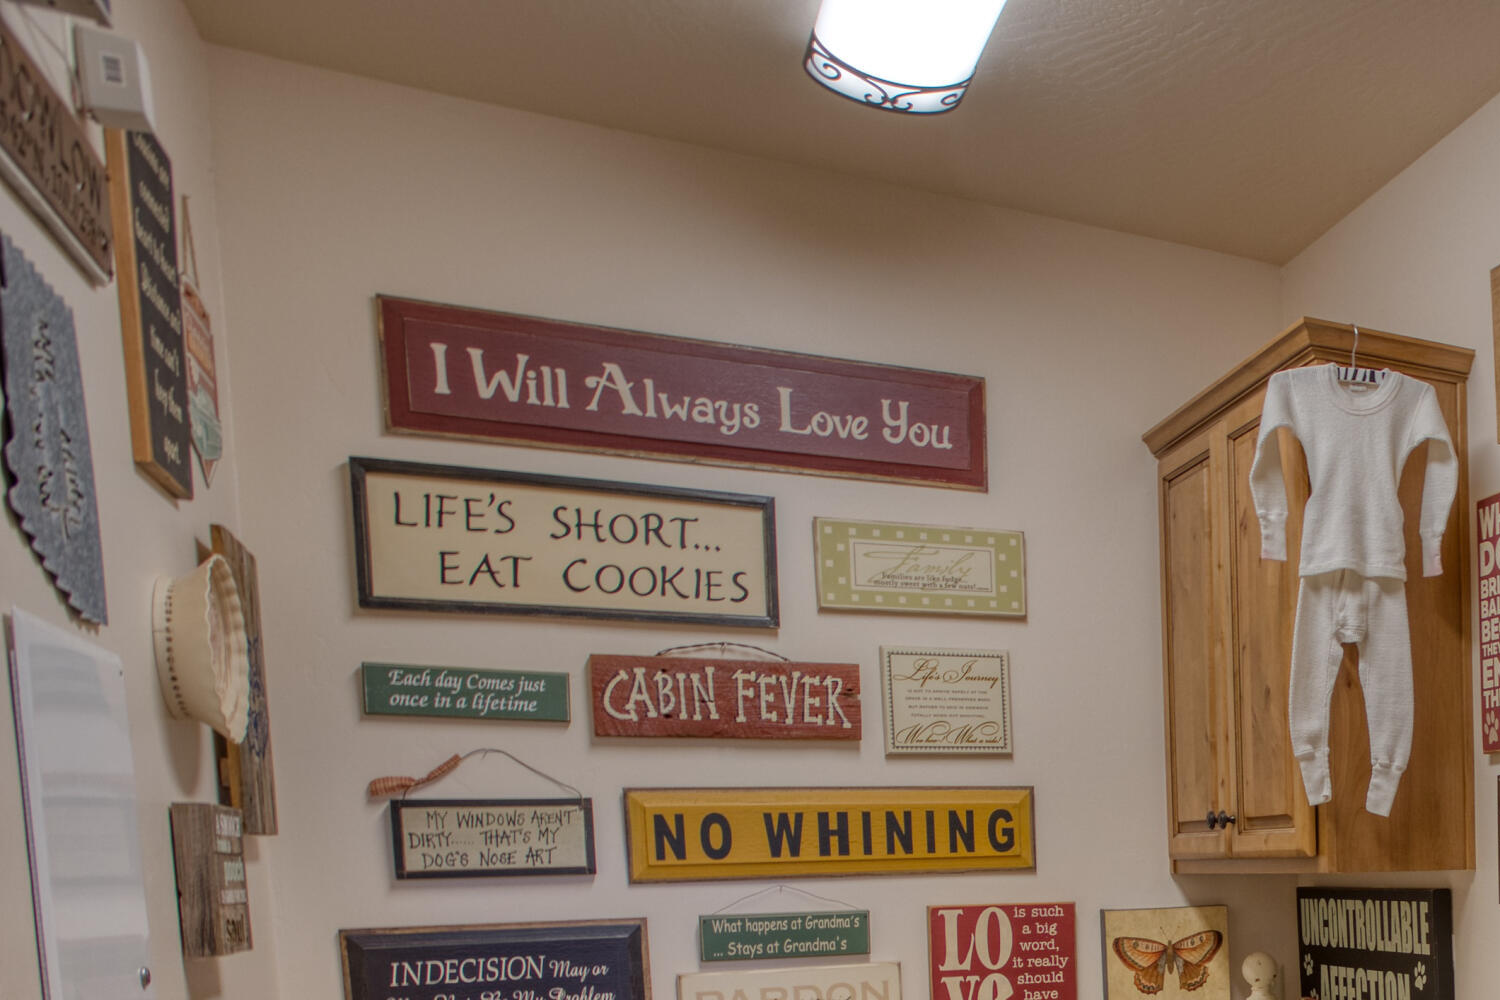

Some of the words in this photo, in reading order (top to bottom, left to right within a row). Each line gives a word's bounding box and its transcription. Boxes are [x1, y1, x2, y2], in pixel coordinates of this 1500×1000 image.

[430, 342, 452, 394] I
[466, 347, 569, 408] Will
[585, 363, 760, 435] Always
[779, 387, 868, 440] Love
[881, 399, 953, 449] You
[393, 491, 515, 534] LIFE'S
[551, 505, 721, 552] SHORT...
[439, 551, 532, 588] EAT
[563, 558, 749, 603] COOKIES
[388, 669, 431, 687] Each
[435, 671, 462, 691] day
[467, 673, 514, 691] Comes
[517, 675, 546, 696] just
[389, 694, 429, 709] once
[434, 693, 451, 708] in
[456, 699, 467, 709] a
[471, 694, 538, 716] lifetime
[604, 667, 720, 721] CABIN
[732, 670, 852, 728] FEVER
[426, 810, 447, 827] MY
[457, 810, 525, 826] WINDOWS
[480, 828, 531, 847] THAT'S
[538, 827, 559, 844] MY
[653, 813, 733, 861] NO
[763, 808, 1016, 858] WHINING
[422, 852, 469, 868] DOG'S
[480, 850, 517, 867] NOSE
[526, 848, 557, 865] ART
[1014, 907, 1026, 918] is
[1031, 905, 1064, 917] such
[712, 919, 742, 934] What
[746, 917, 787, 935] happens
[791, 916, 802, 929] at
[805, 915, 859, 930] Grandma's
[1022, 925, 1031, 934] a
[1036, 922, 1058, 936] big
[1300, 898, 1430, 955] UNCONTROLLABLE
[727, 942, 763, 958] Stays
[767, 941, 779, 953] at
[784, 936, 847, 952] Grandma's
[1020, 940, 1059, 951] word,
[390, 955, 546, 987] INDECISION
[550, 960, 589, 982] May
[593, 965, 609, 977] or
[1012, 957, 1023, 968] it
[1027, 956, 1068, 968] really
[1018, 972, 1064, 984] should
[1024, 990, 1058, 1000] have
